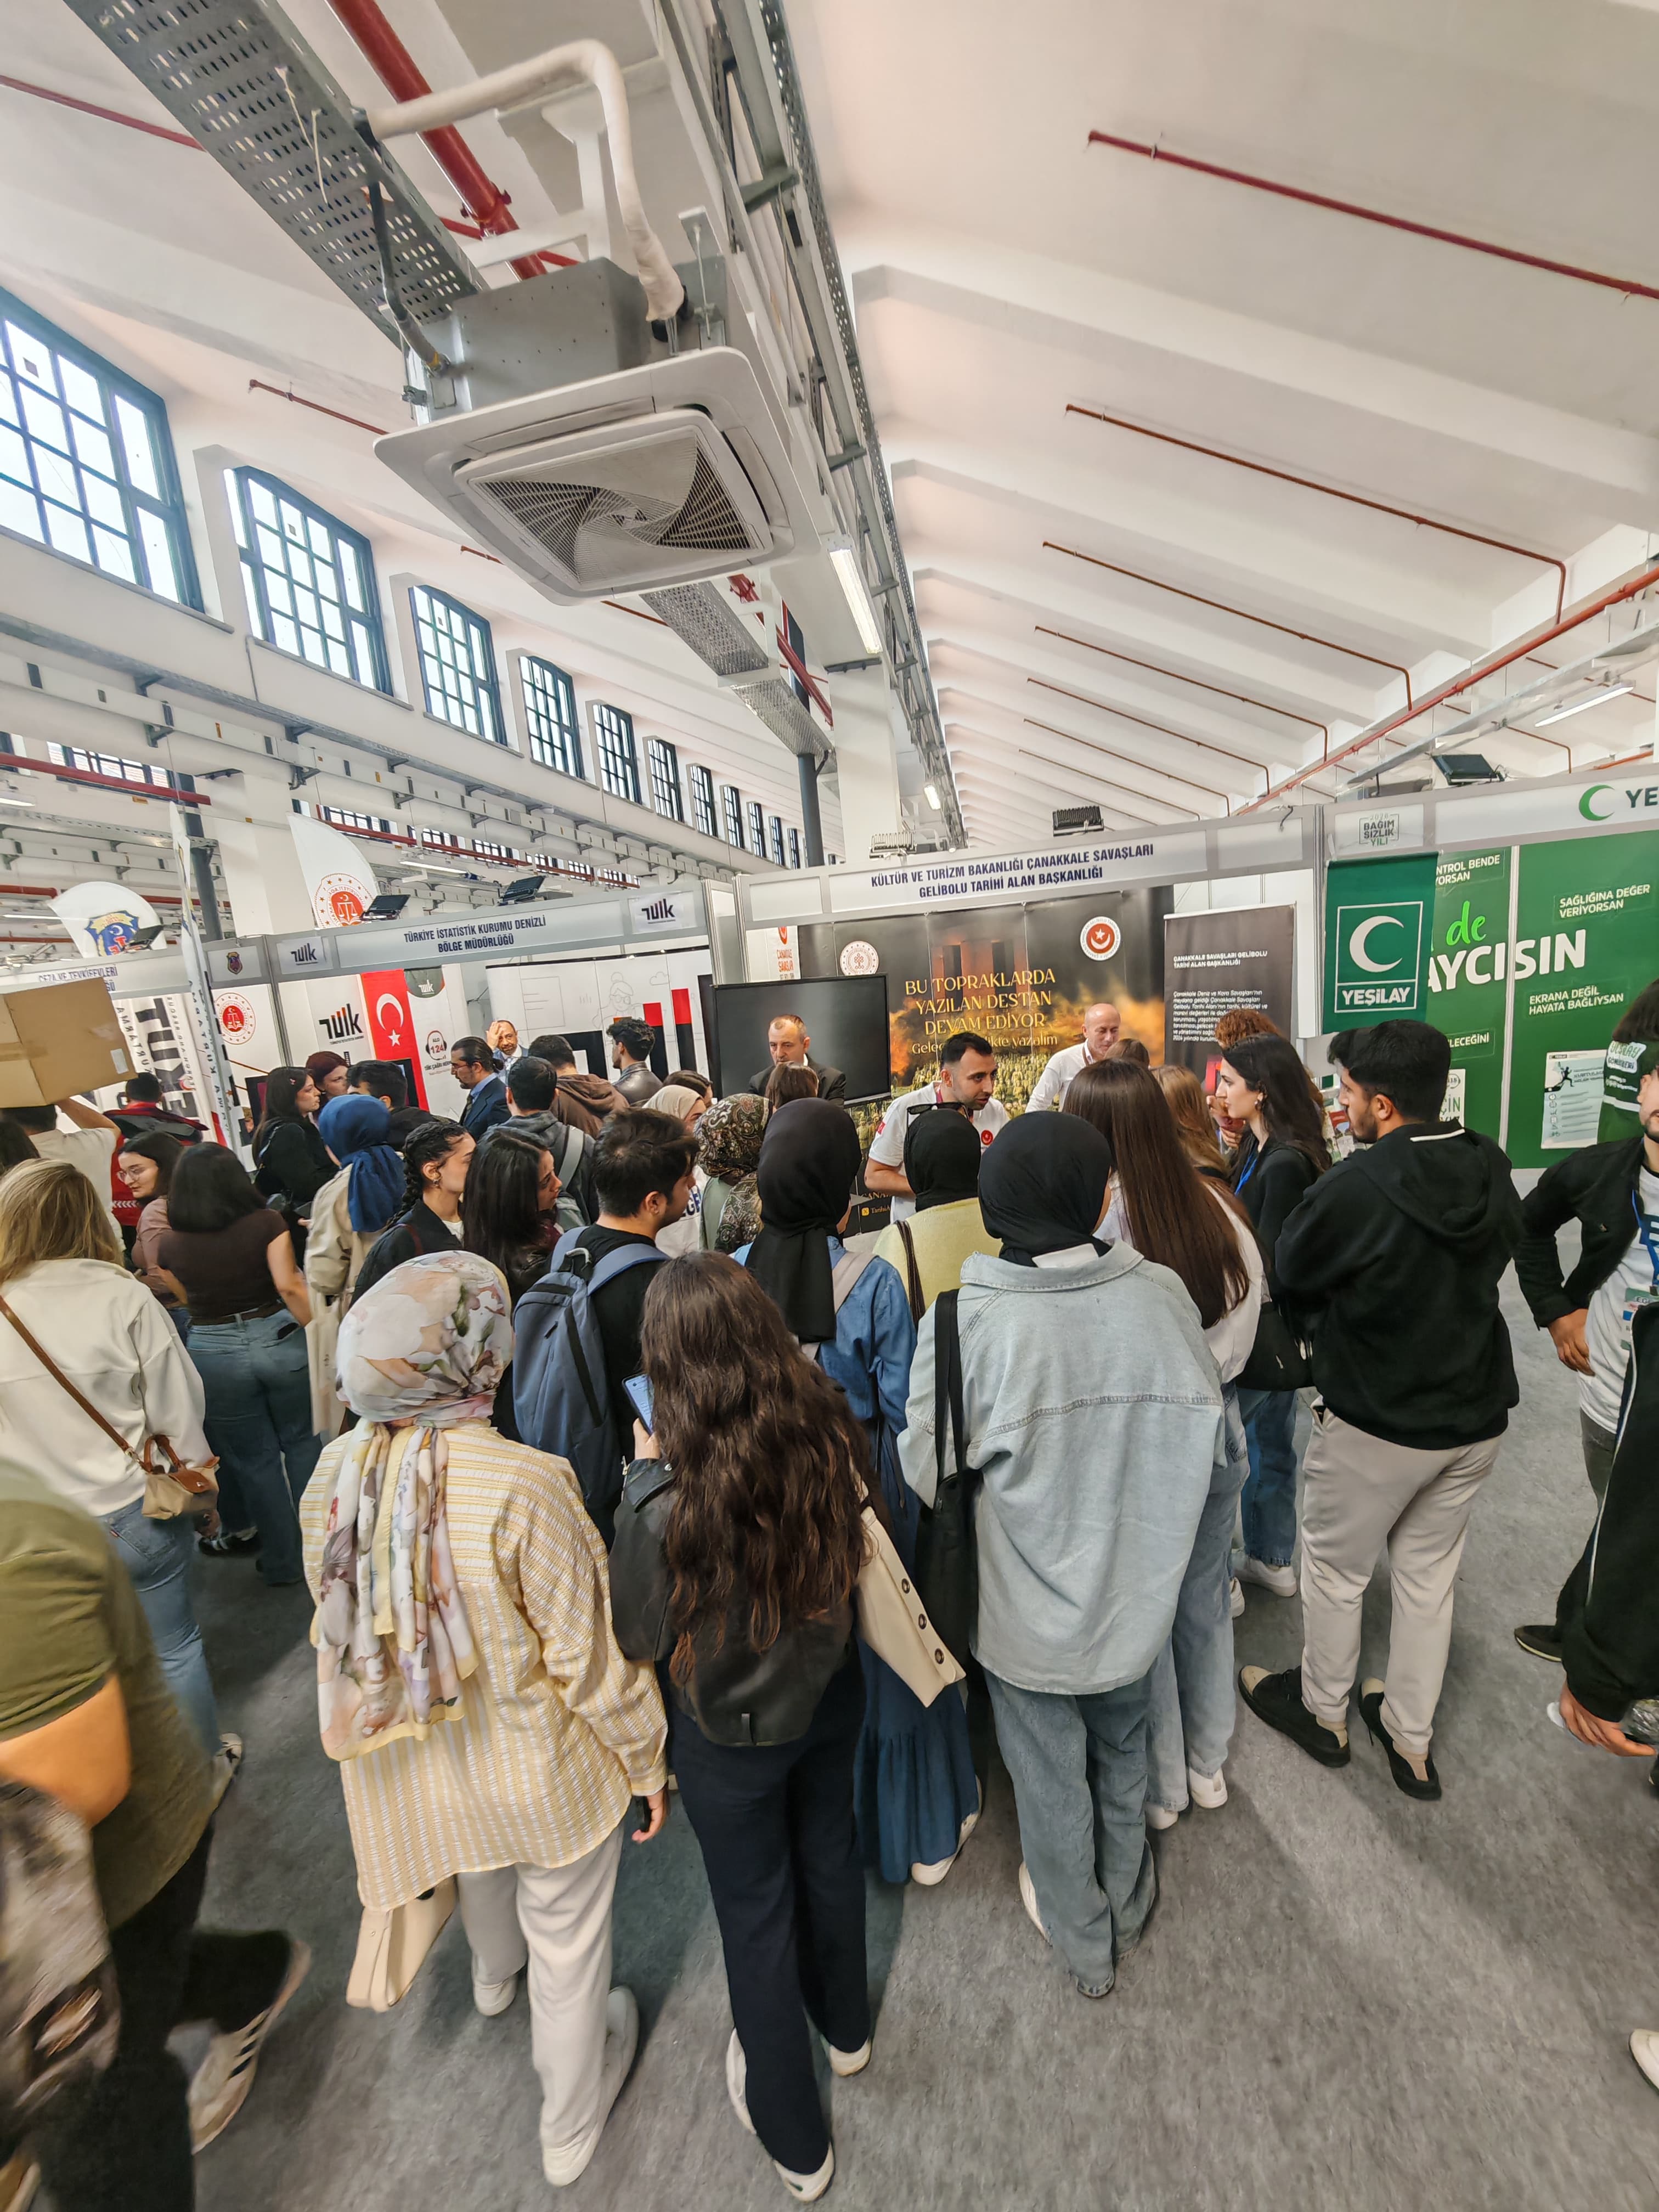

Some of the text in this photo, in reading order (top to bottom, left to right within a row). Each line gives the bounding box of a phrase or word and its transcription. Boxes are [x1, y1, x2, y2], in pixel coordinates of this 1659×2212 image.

[1364, 828, 1394, 839] SIZLIK
[1371, 838, 1388, 846] YILI
[871, 844, 1153, 887] KÜLTÜR VE TURİZM BAKANLIĞI ÇANAKKALE SAVAŞLARI
[1469, 854, 1500, 870] BENDE
[919, 881, 967, 898] GELİBOLU
[1007, 874, 1035, 888] ALAN
[1039, 865, 1103, 885] BAŞKANLIĞI
[1560, 884, 1651, 908] SAĞLIĞINA DEĞER
[1559, 899, 1624, 918] VERİYORSAN
[404, 915, 546, 943] TÜRKİYE İSTATİSTİK KURUMU DENİZLİ
[1446, 900, 1487, 946] de
[438, 933, 514, 952] BÖLGE MÜDÜRLÜĞÜ
[906, 968, 1056, 995] BU TOPRAKLARDA
[916, 990, 1052, 1015] YAZILAN DESTAN
[1342, 987, 1411, 1006] YEŞİLAY
[1529, 992, 1624, 1015] HAYATA BAĞLIYSAN
[1530, 985, 1600, 1005] EKRANA DEĞİL
[925, 1012, 1045, 1036] DEVAM EDİYOR
[431, 1045, 444, 1054] 124
